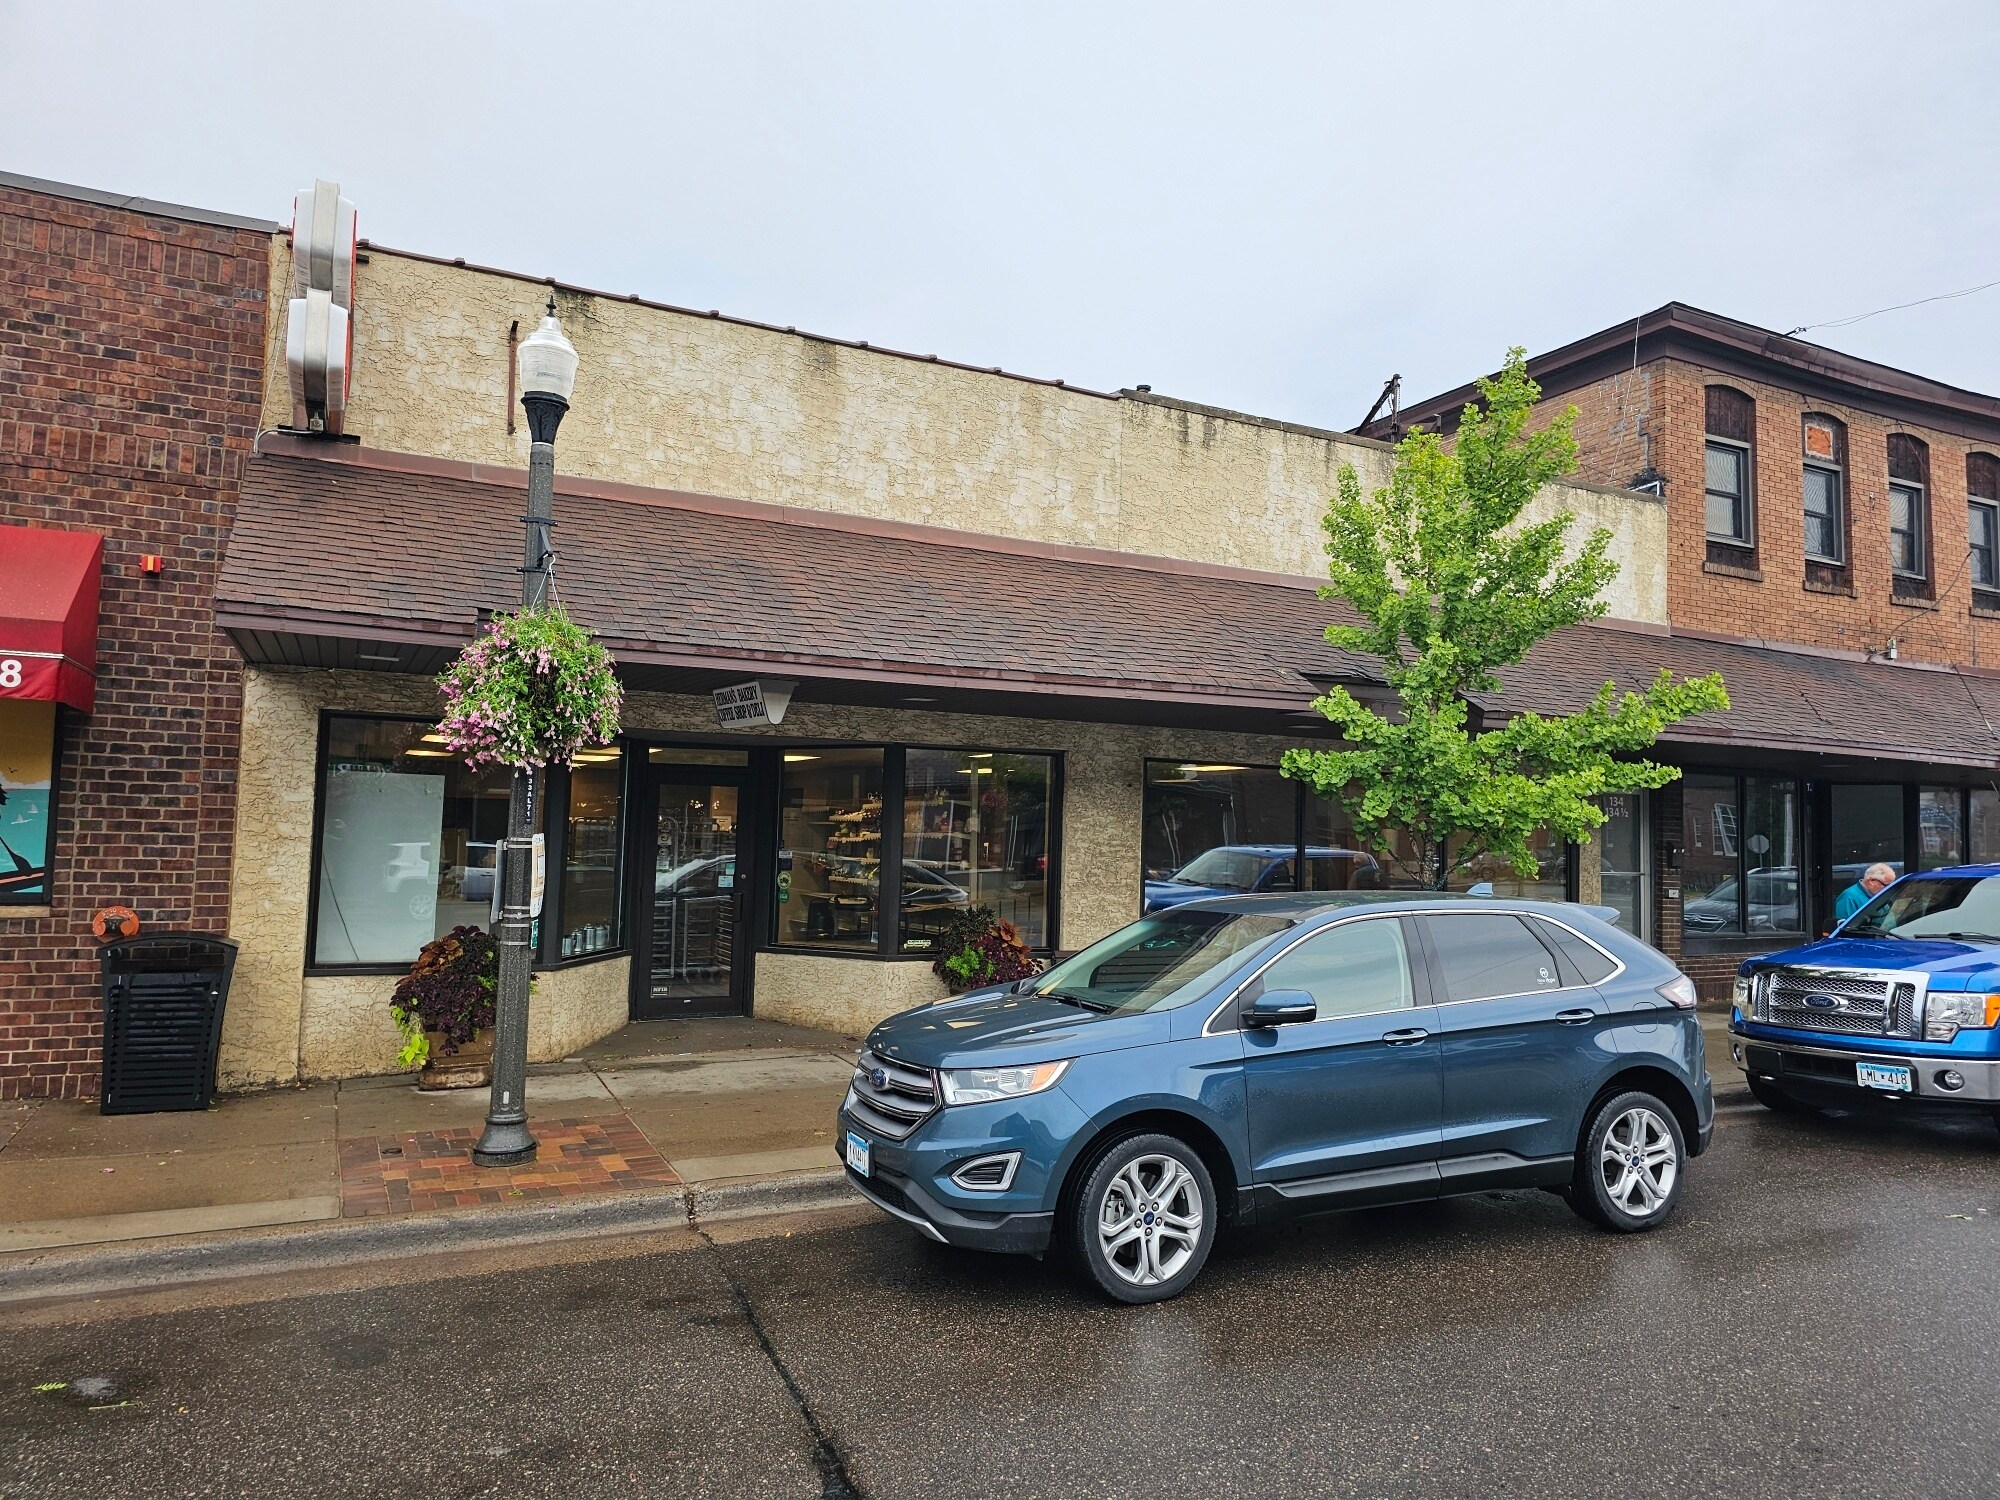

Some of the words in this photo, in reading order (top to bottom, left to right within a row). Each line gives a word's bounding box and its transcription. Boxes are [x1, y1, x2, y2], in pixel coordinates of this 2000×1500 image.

[737, 685, 758, 703] BAKERY
[718, 707, 736, 722] COFFEE
[734, 705, 748, 720] SHOP
[751, 702, 766, 717] DELI
[1609, 796, 1624, 807] 134
[1810, 996, 1829, 1006] Ford
[1860, 1069, 1880, 1083] LML
[1887, 1072, 1908, 1085] 418
